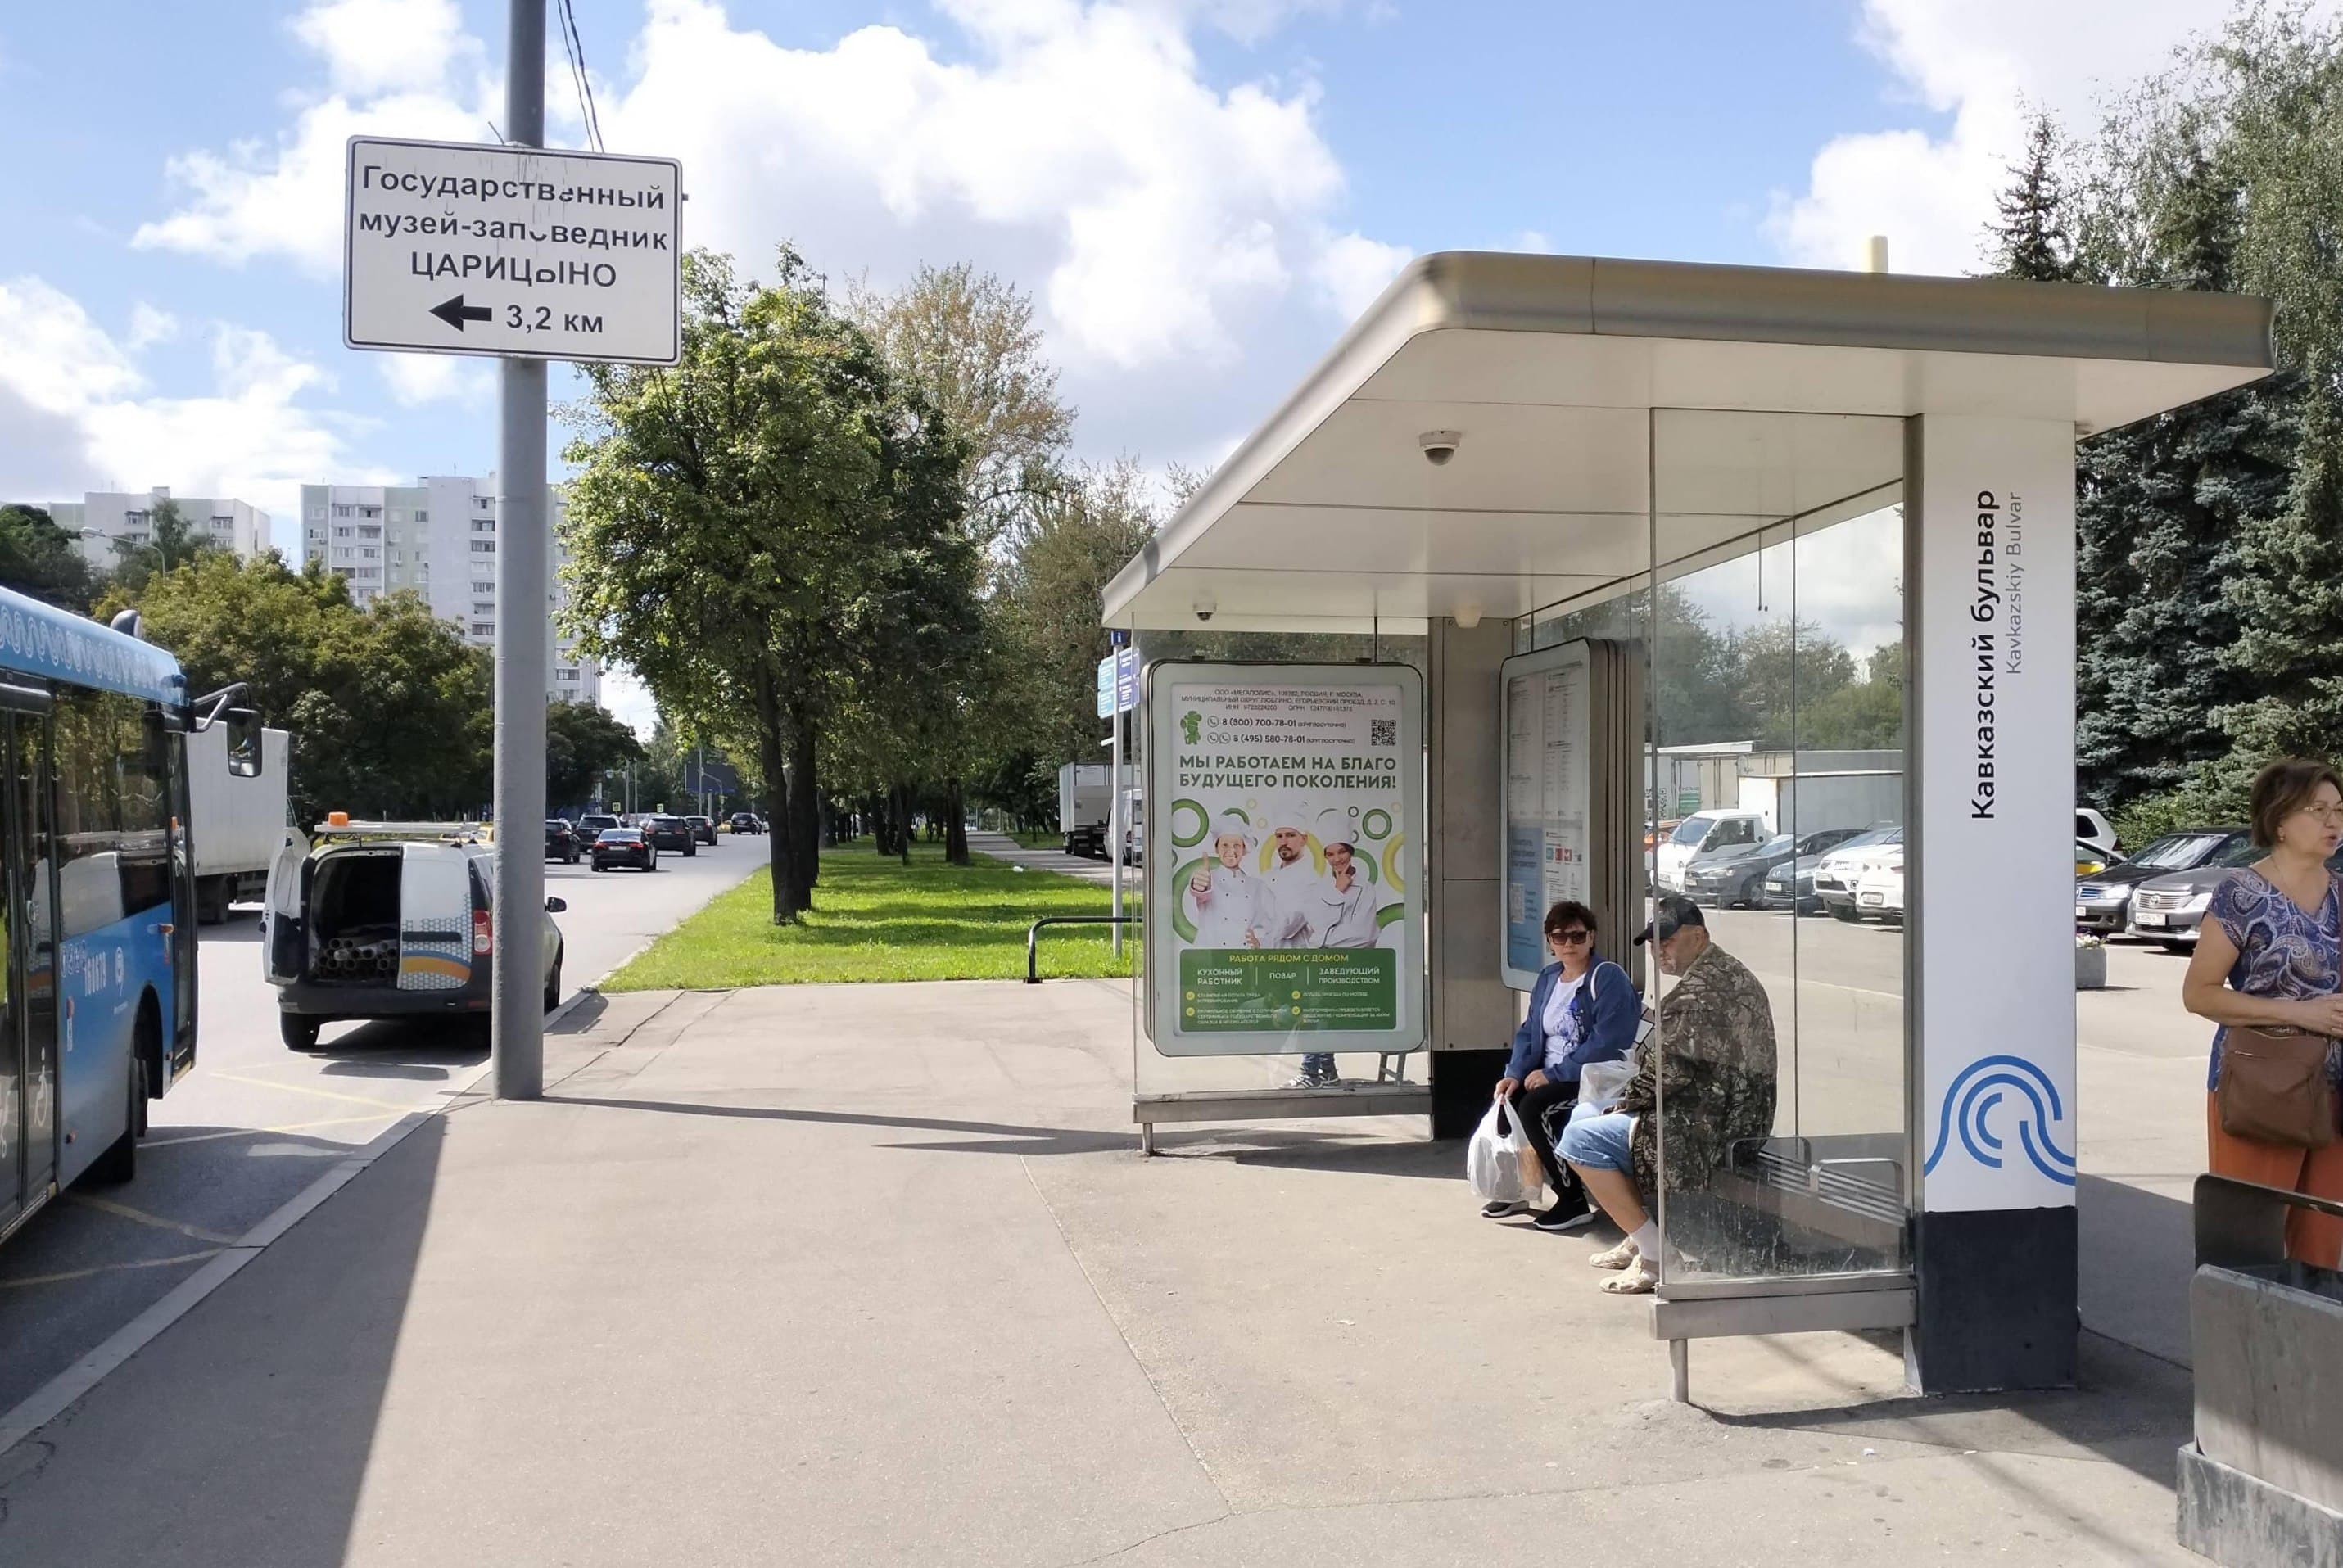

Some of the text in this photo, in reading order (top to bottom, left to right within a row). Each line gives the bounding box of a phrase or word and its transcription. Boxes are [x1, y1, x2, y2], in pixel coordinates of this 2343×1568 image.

[363, 165, 664, 210] Государственный
[506, 304, 604, 334] 3,2 км
[2005, 492, 2025, 675] Kavkazskiy Bulvar
[1970, 490, 2001, 820] Кавказский бульвар
[1255, 719, 1296, 727] 700-78-01
[1240, 734, 1263, 743] (495)
[1179, 755, 1396, 770] МЫ РАБОТАЕМ НА БЛАГО
[1179, 773, 1396, 789] БУДУЩЕГО ПОКОЛЕНИЯ!
[1229, 954, 1350, 963] РАБОТА РЯДОМ С ДОМОМ
[1197, 967, 1243, 976] КУХОННЫЙ
[1269, 972, 1297, 980] ПОВАР
[1319, 966, 1380, 976] ЗАВЕДУЮЩИЙ
